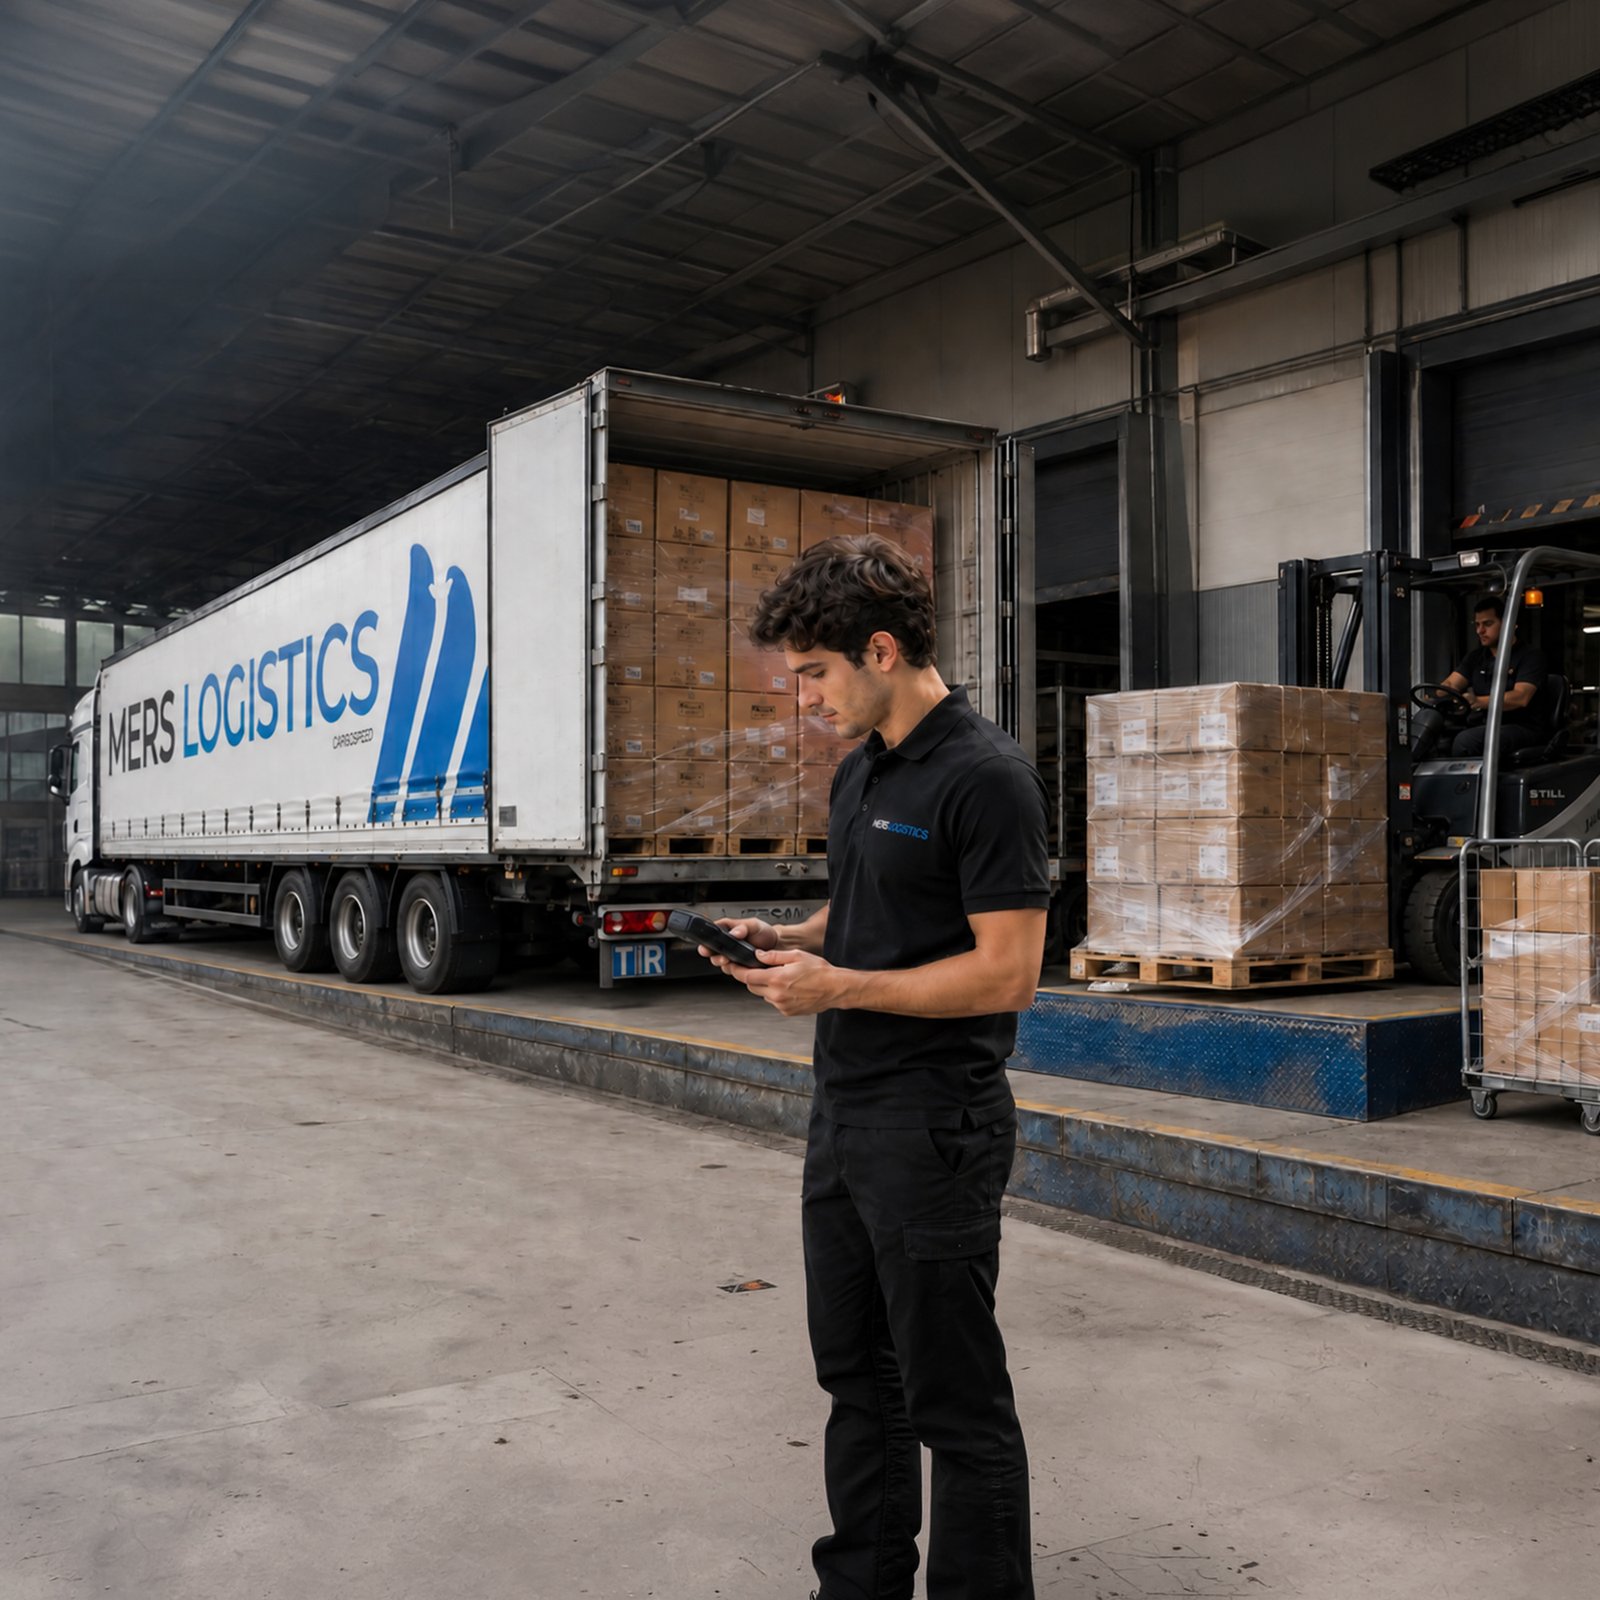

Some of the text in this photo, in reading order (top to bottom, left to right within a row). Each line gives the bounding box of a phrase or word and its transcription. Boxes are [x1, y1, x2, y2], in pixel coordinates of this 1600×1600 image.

[108, 609, 379, 777] MERS LOGISTICS
[1529, 789, 1565, 799] STILL
